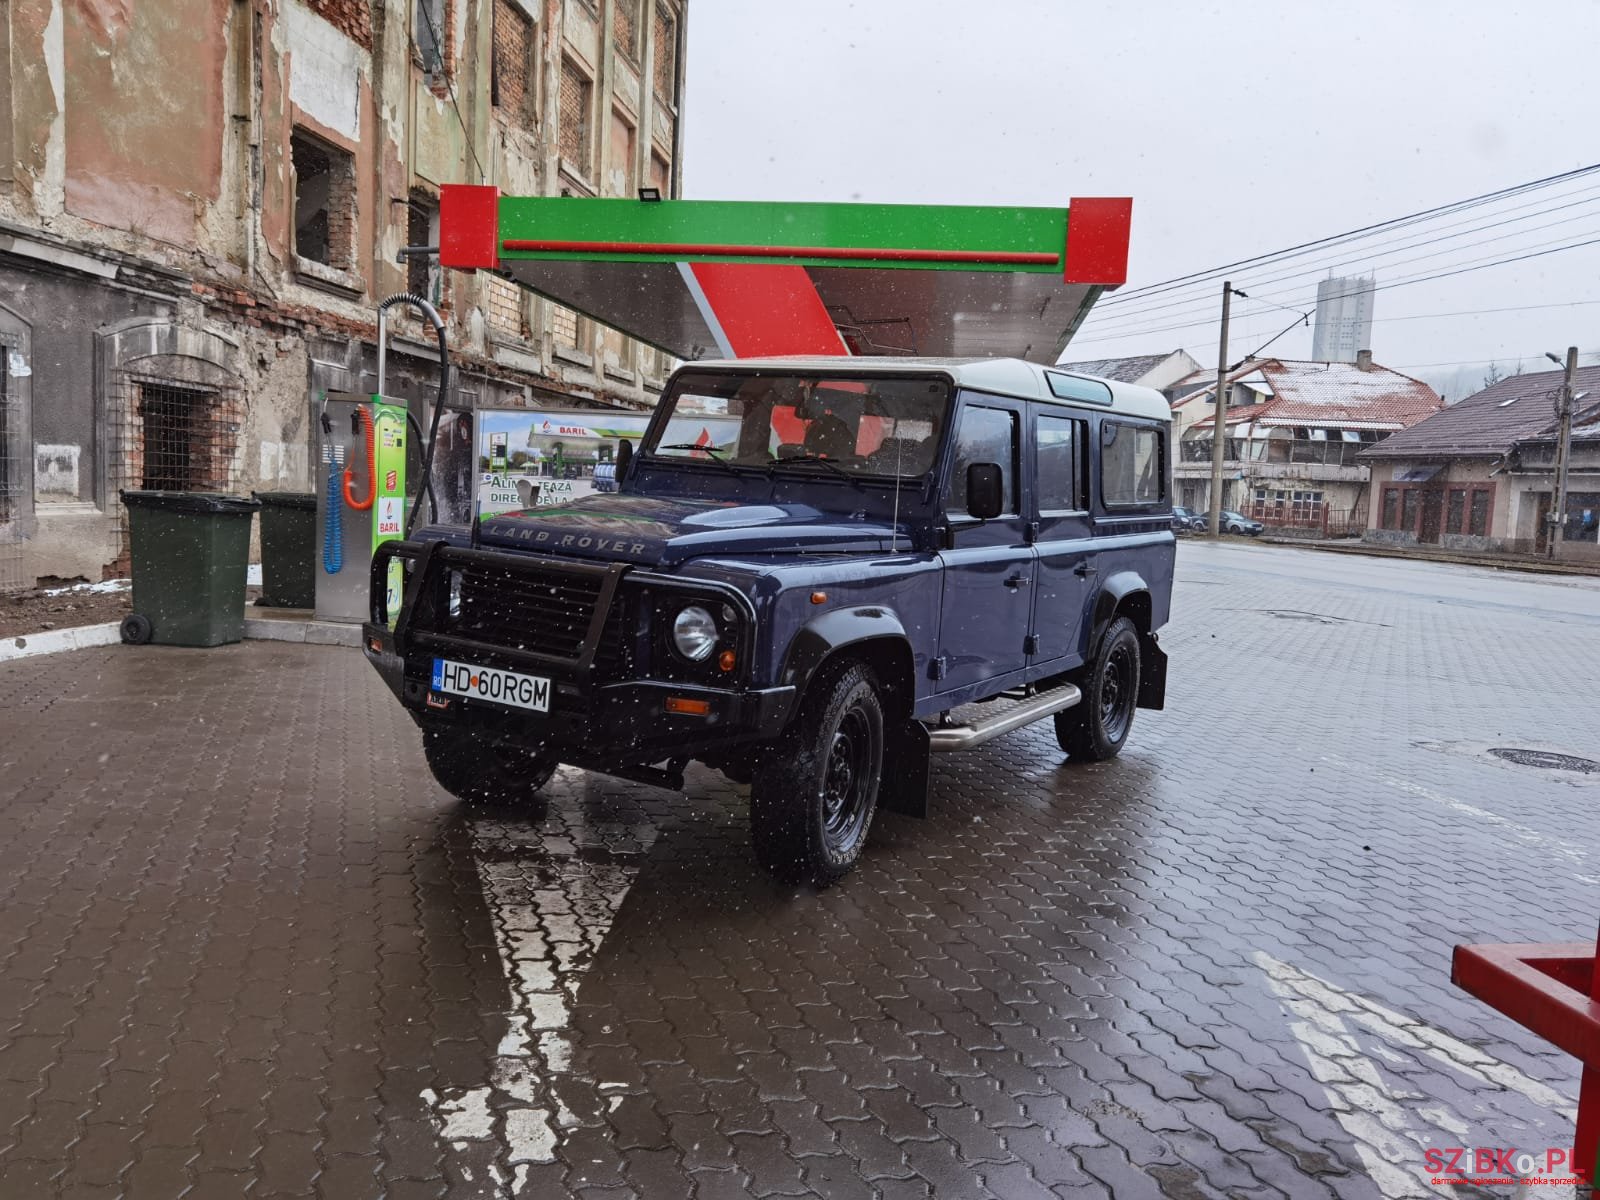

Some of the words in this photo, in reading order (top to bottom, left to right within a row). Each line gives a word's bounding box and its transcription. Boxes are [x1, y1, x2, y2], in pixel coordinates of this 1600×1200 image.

[559, 426, 588, 436] BARIL
[379, 522, 400, 533] BARIL
[489, 525, 550, 542] LAND
[560, 534, 646, 555] ROVER
